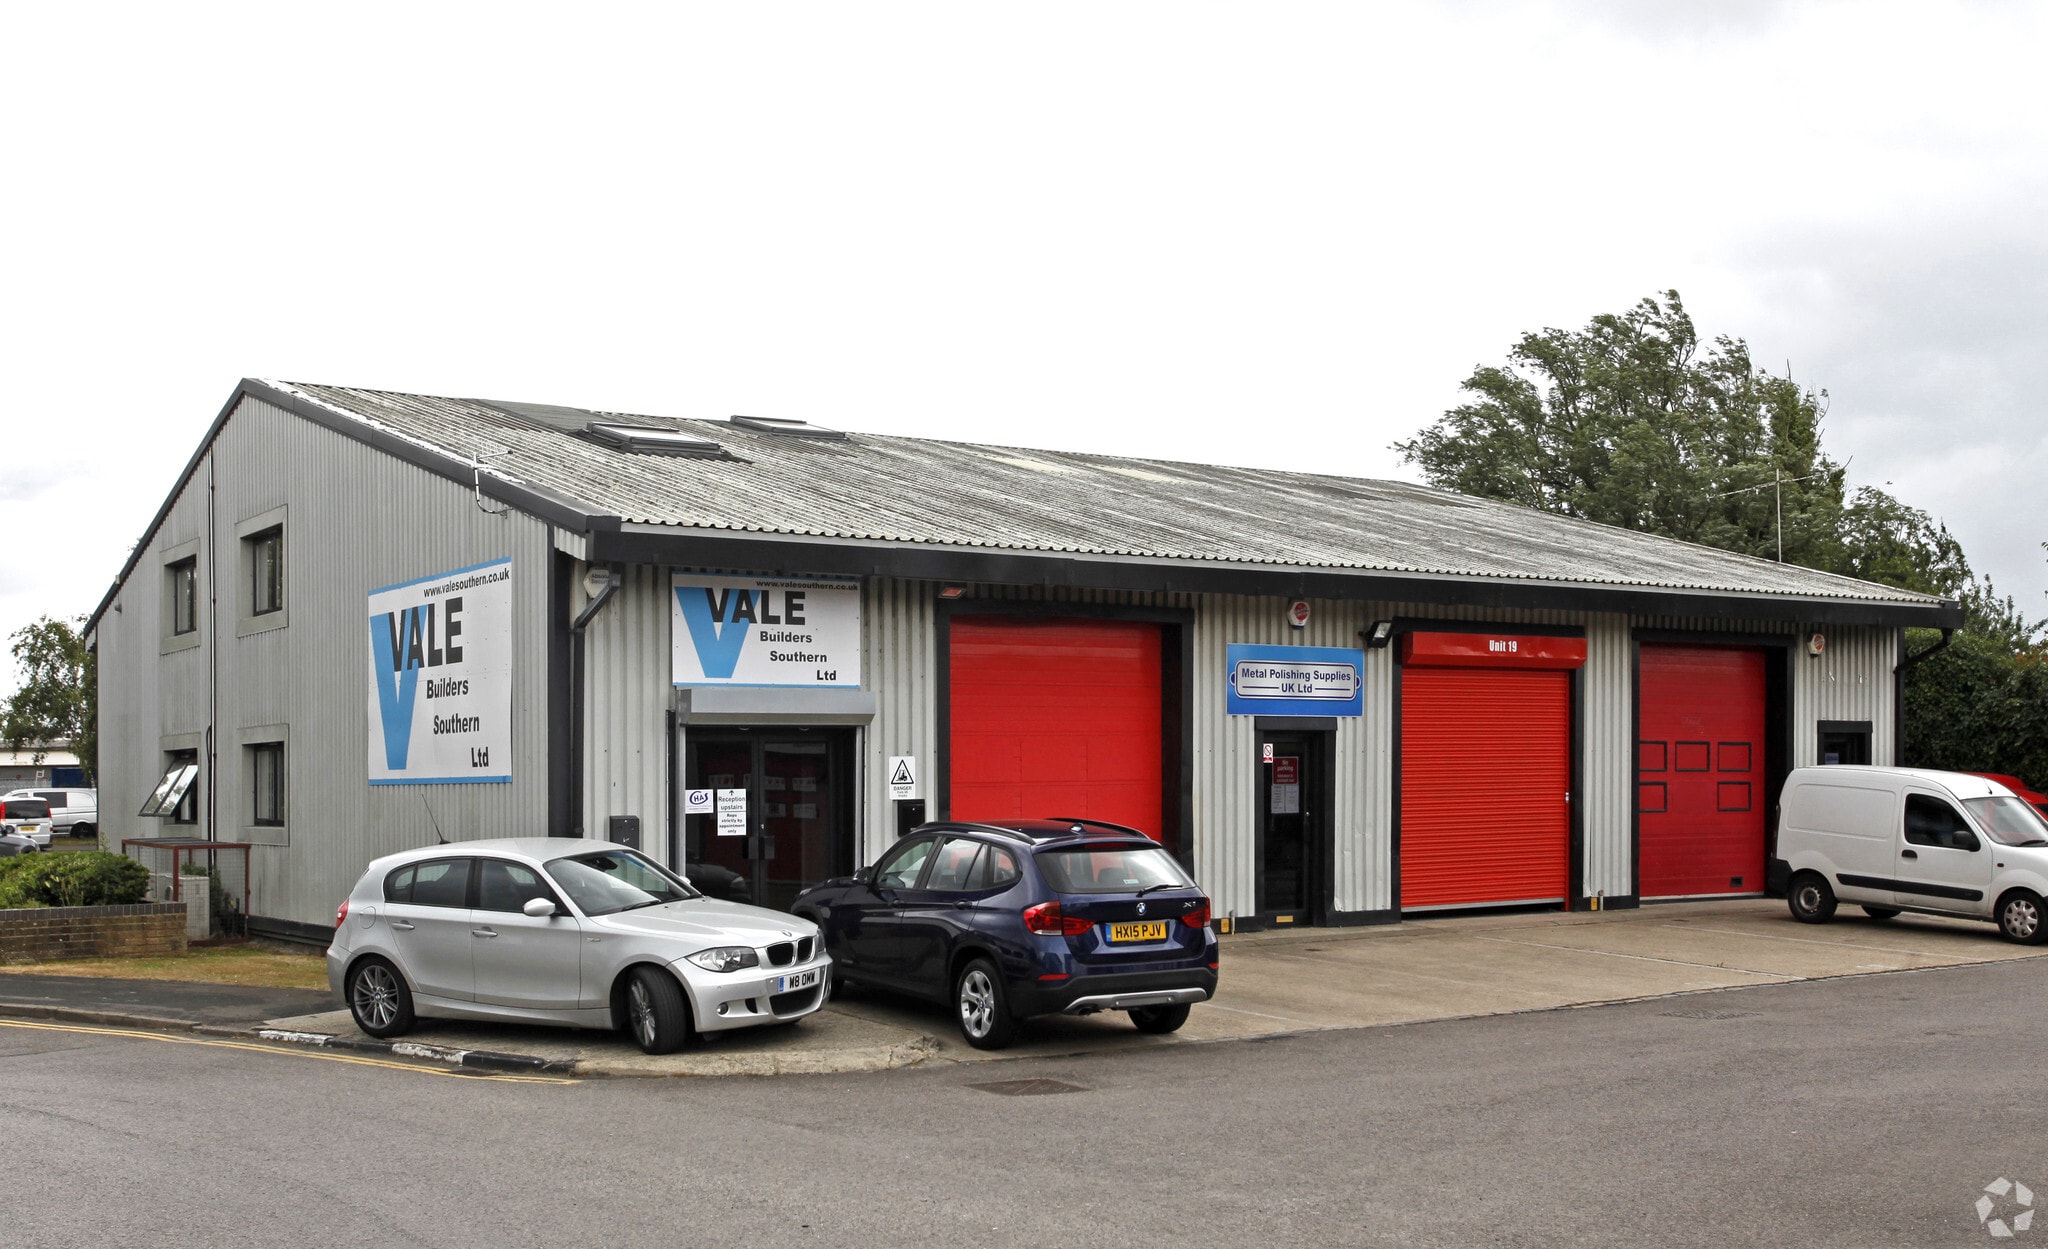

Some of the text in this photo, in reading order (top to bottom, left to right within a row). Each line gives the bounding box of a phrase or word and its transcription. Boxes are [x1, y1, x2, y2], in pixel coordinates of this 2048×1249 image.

[424, 567, 510, 598] www.valesouthern.co.uk
[756, 580, 858, 591] www.valesouthern.co.uk
[705, 587, 806, 626] VALE
[388, 596, 463, 673] VALE
[760, 631, 813, 643] Builders
[1489, 639, 1518, 653] Unit 19
[769, 650, 828, 663] Southern
[816, 669, 837, 681] Ltd
[1241, 667, 1351, 683] Metal Polishing Supplies
[426, 677, 469, 700] Builders
[1281, 683, 1313, 694] UK Ltd
[433, 712, 480, 735] Southern
[471, 746, 490, 768] Ltd
[689, 790, 709, 805] CHAS
[1115, 924, 1161, 939] HX15 PJV
